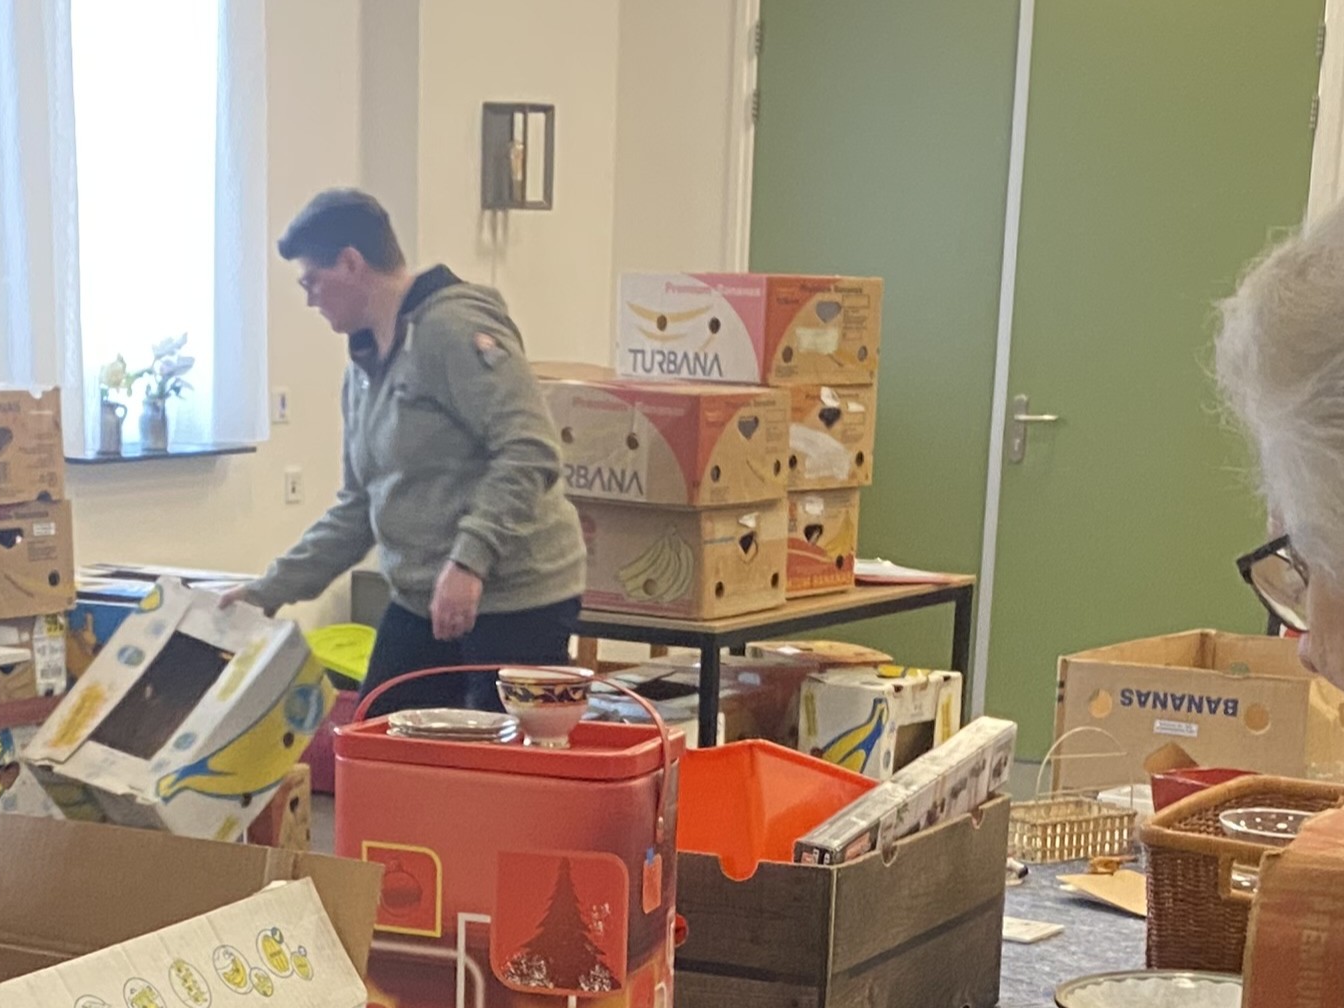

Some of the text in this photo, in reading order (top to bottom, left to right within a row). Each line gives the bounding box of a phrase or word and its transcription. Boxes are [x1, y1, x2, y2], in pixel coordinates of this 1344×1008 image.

[627, 348, 724, 378] TURBANA
[562, 463, 645, 497] RBANA
[1119, 687, 1240, 718] BANANAS
